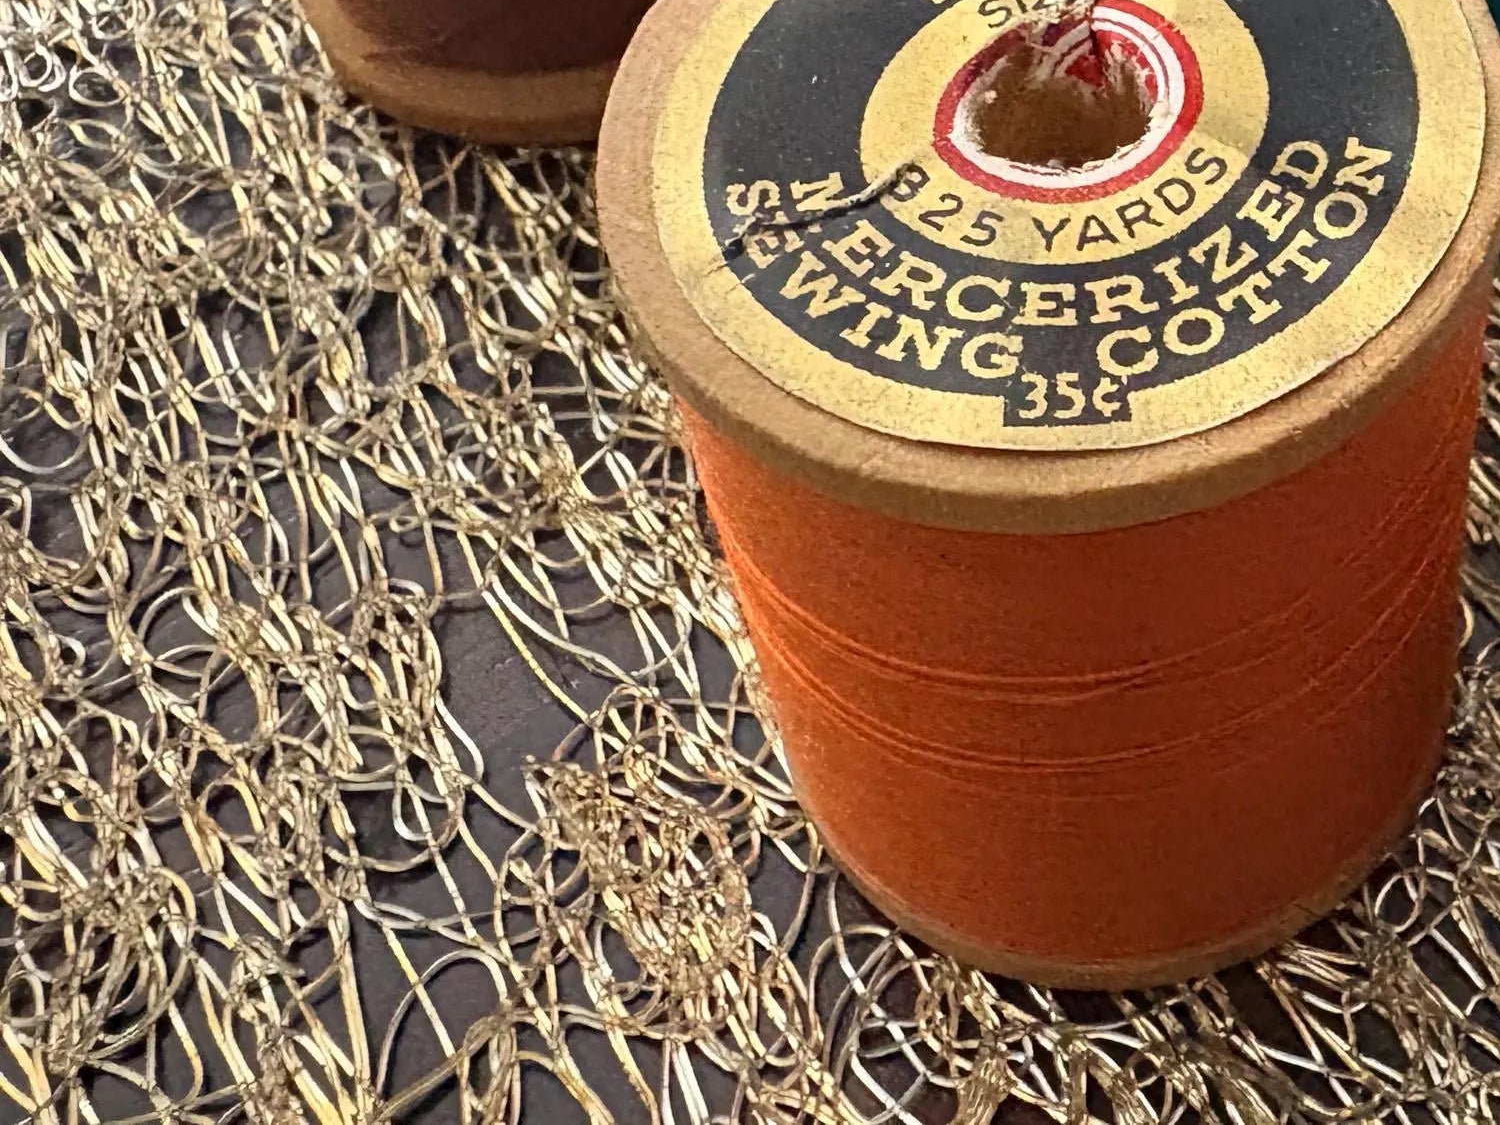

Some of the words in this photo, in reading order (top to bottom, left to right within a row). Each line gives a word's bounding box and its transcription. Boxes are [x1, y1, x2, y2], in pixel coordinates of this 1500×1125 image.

[724, 178, 1024, 380] SEWING
[1095, 135, 1398, 379] COTTON
[788, 139, 1331, 327] MERCERIZED
[1033, 144, 1231, 253] YARDS
[1016, 374, 1128, 420] 35¢
